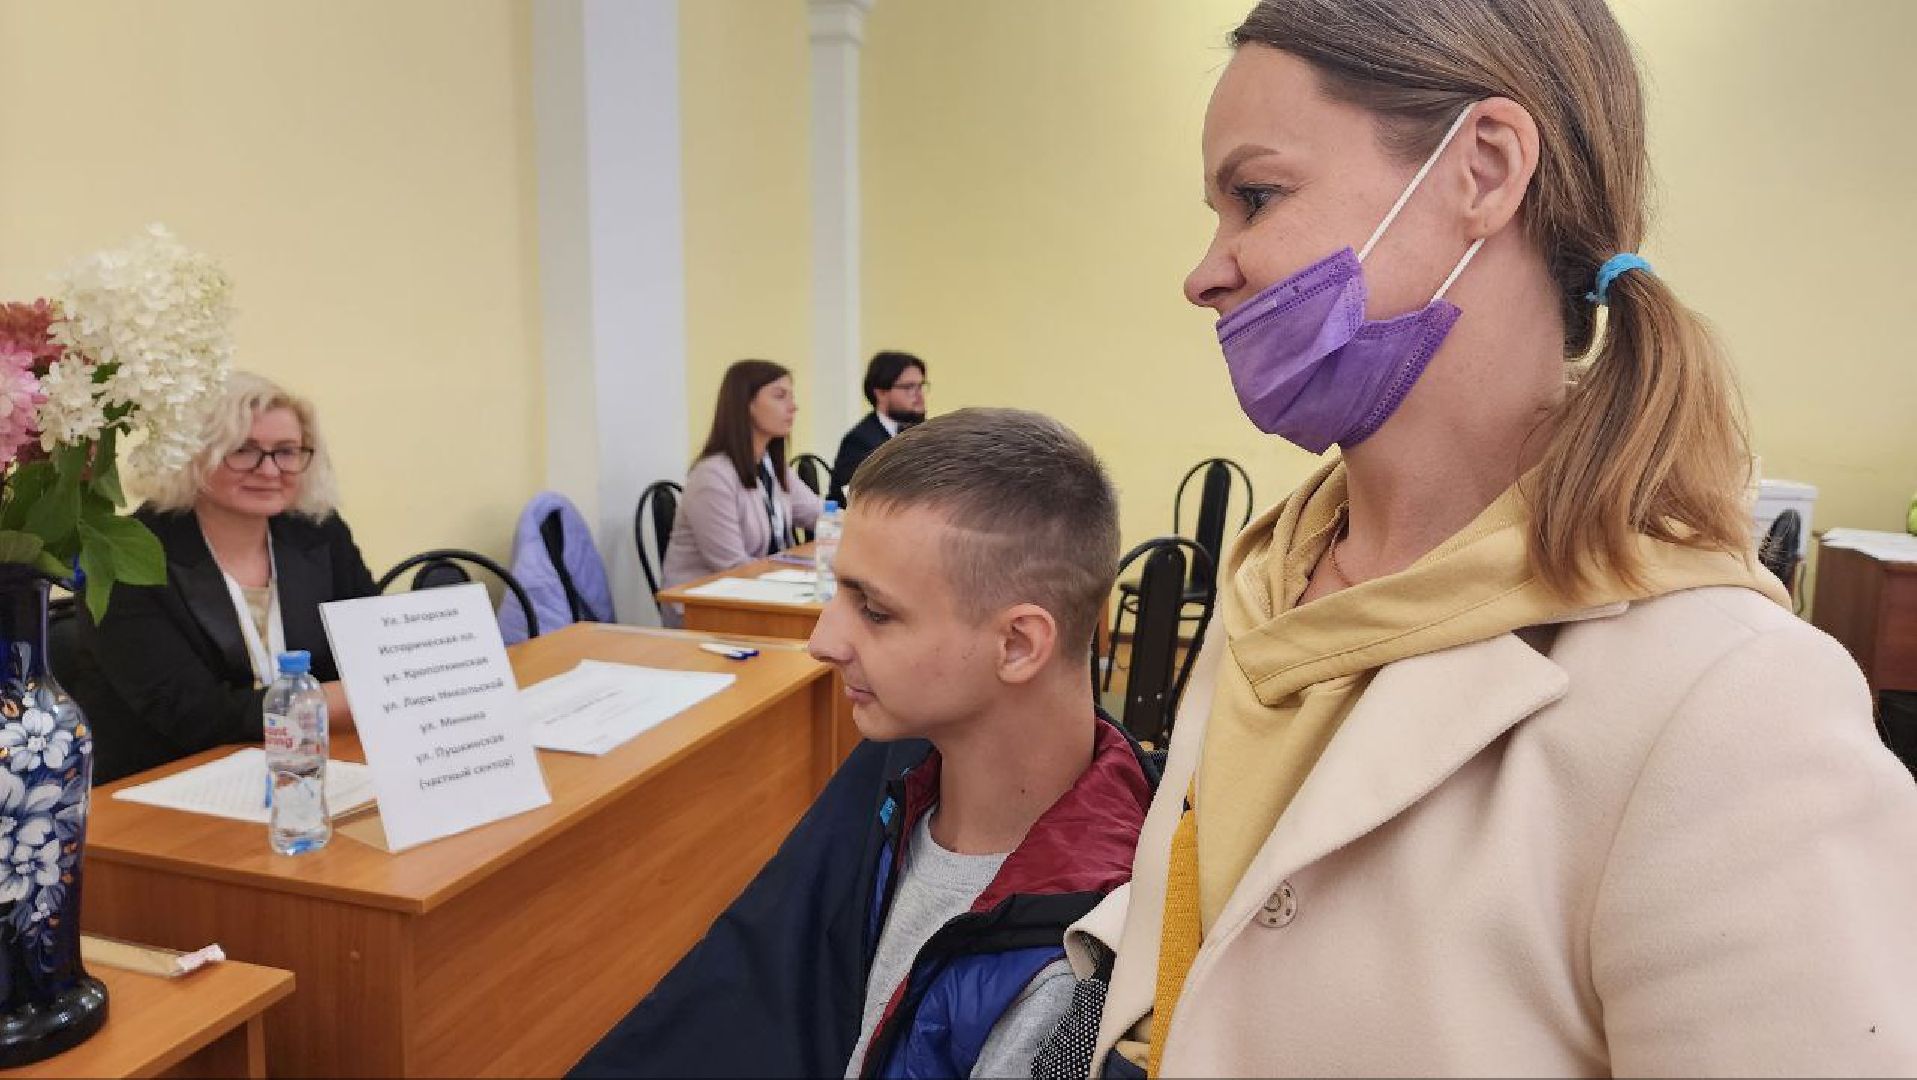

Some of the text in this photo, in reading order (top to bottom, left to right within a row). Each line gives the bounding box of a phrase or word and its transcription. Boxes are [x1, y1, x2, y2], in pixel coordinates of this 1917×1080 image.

[381, 608, 459, 627] Ул. Загорская
[378, 632, 476, 655] Историческая пл.
[384, 656, 488, 686] ул. Кропоткинская
[383, 678, 504, 714] ул. Лиры Никольской
[419, 710, 487, 735] ул. Минина
[416, 734, 504, 766] ул. Пушкинская
[419, 753, 515, 790] (частный сектор)
